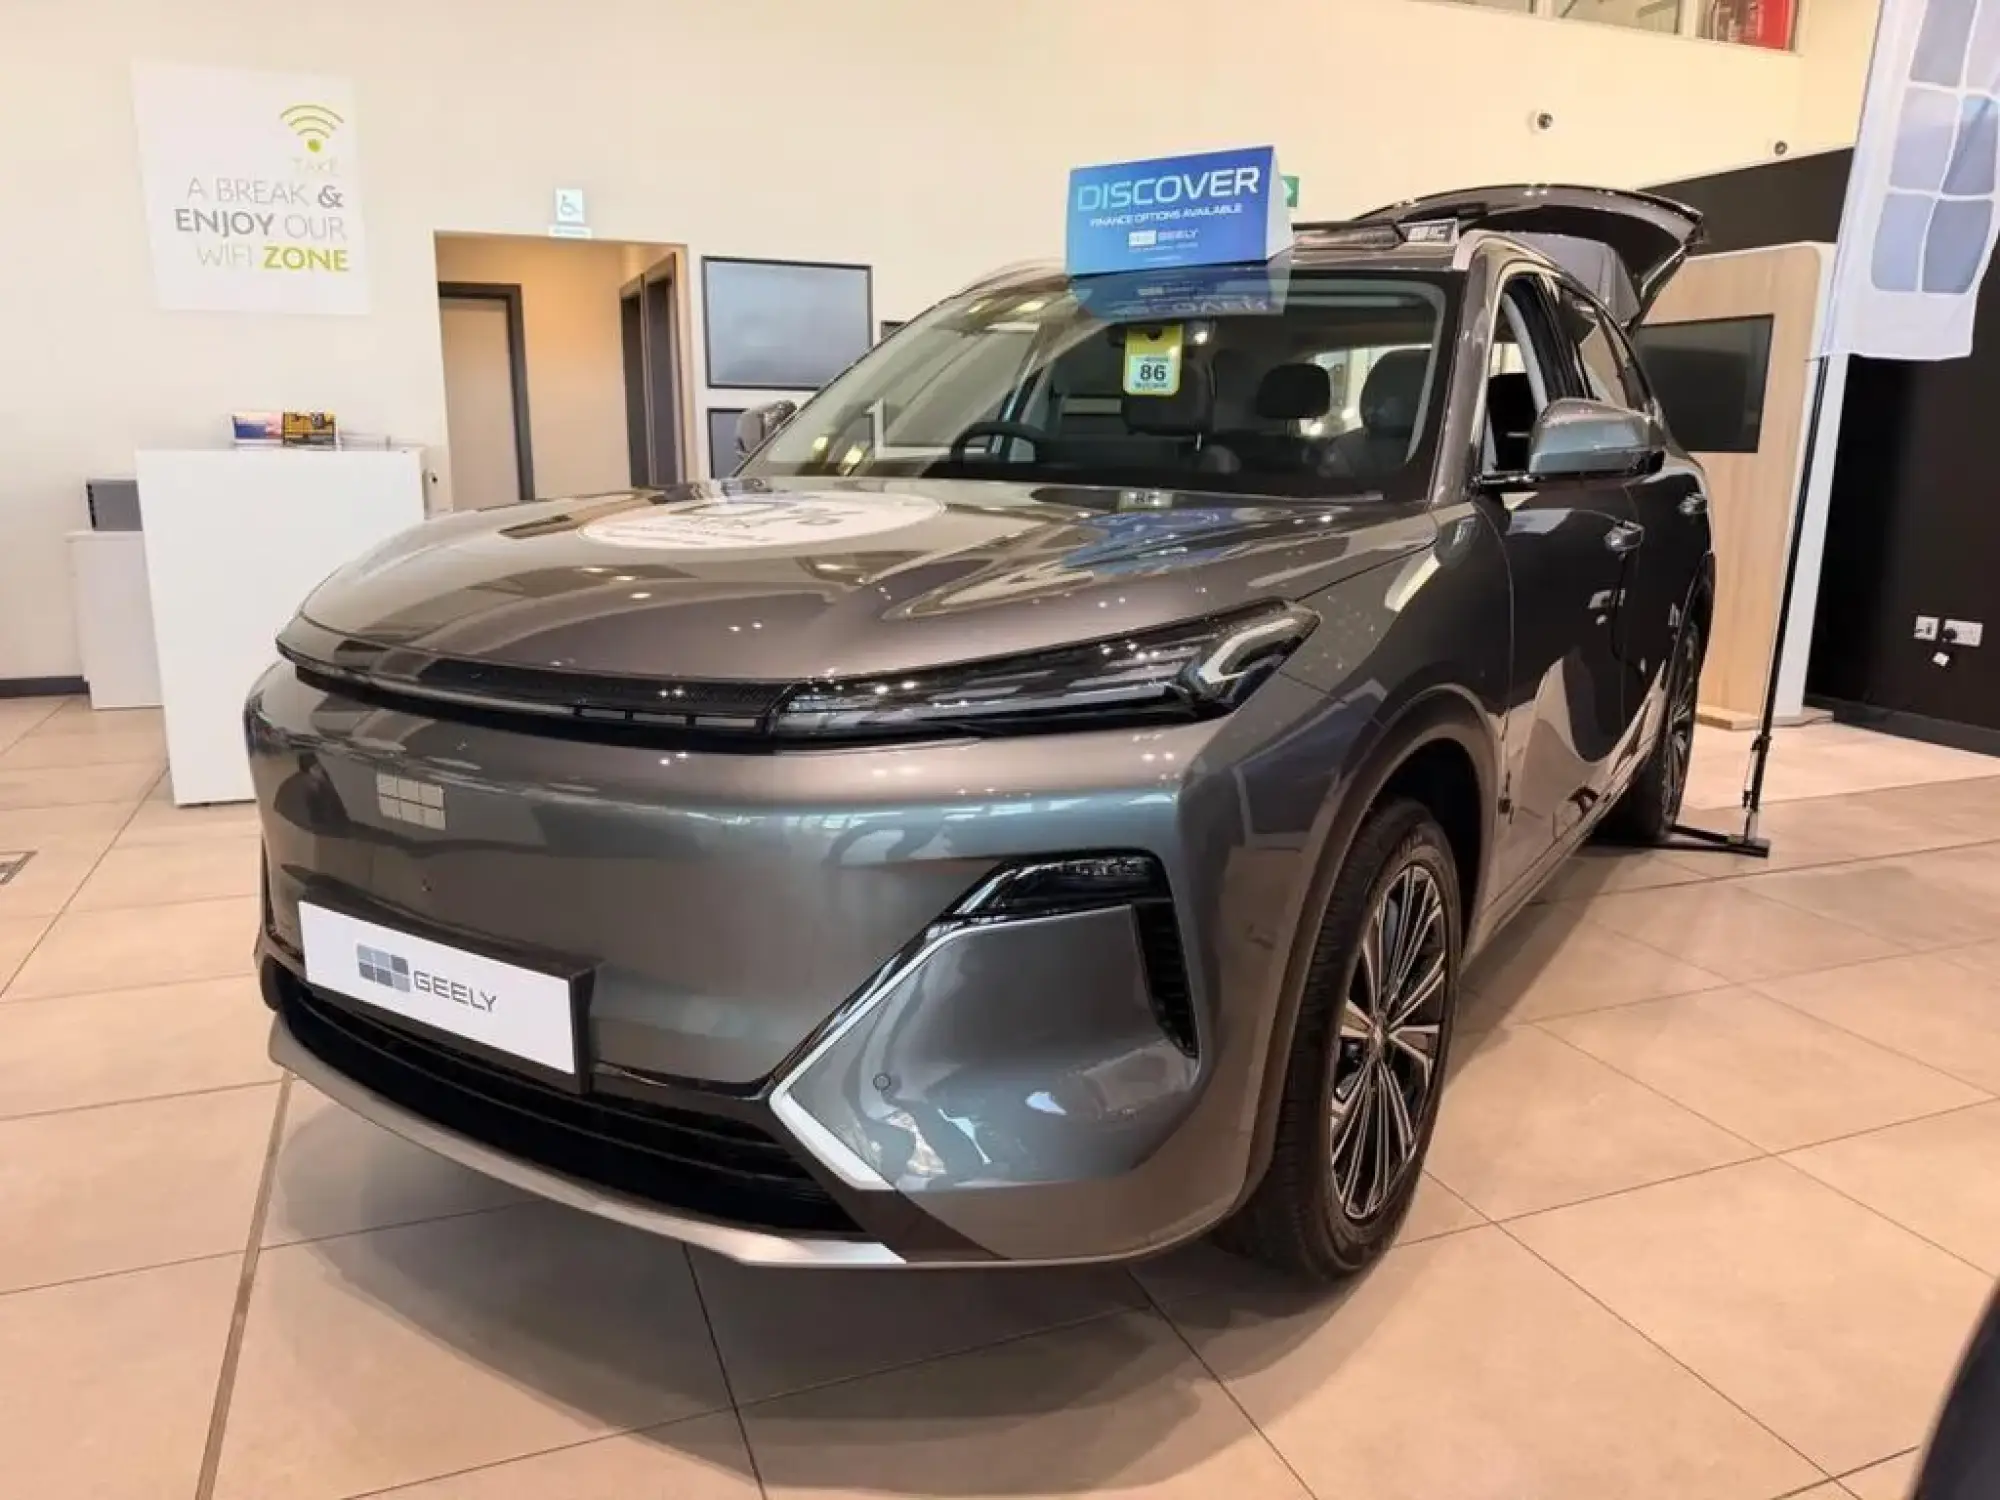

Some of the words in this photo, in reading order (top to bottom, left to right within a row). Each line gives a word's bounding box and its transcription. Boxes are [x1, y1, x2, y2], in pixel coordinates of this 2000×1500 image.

[292, 158, 337, 175] TAKE
[187, 177, 207, 198] A
[216, 178, 309, 206] BREAK
[318, 185, 344, 208] &
[1077, 167, 1260, 212] DISCOVER
[174, 208, 274, 237] ENJOY
[284, 214, 347, 240] OUR
[197, 245, 252, 266] WIFI
[263, 246, 348, 272] ZONE
[1140, 364, 1167, 381] 86
[413, 971, 497, 1012] GEELY
